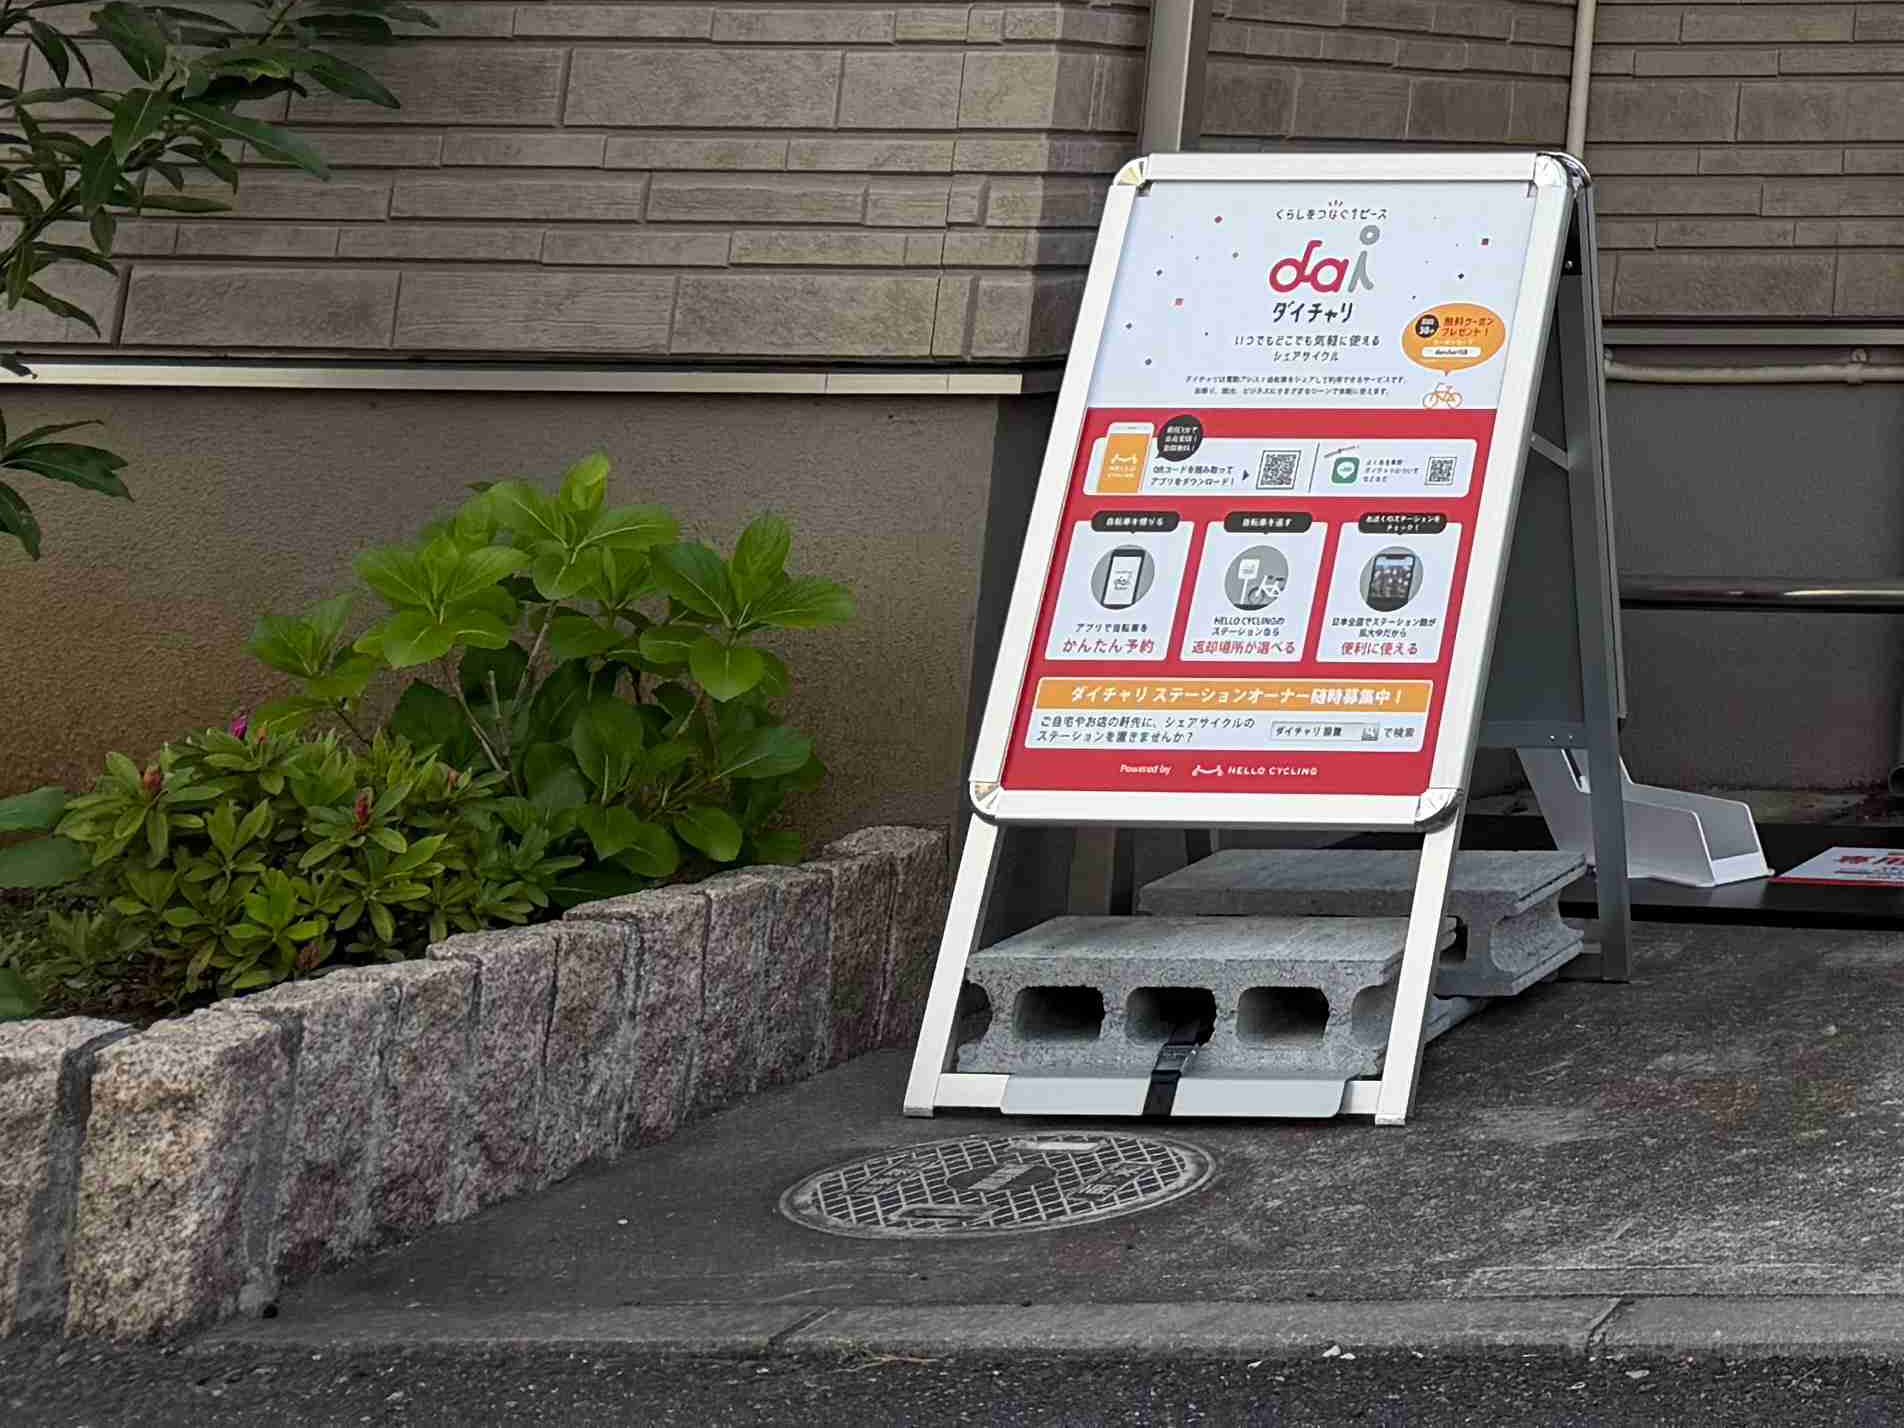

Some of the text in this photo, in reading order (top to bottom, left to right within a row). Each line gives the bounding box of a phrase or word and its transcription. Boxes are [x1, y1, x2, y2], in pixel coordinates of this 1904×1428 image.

[1269, 224, 1381, 293] dai
[1272, 300, 1354, 324] ダイチャリ
[1234, 334, 1381, 347] いつでもどこでも気軽に使える
[1272, 351, 1340, 362] シェアサイクル
[1074, 623, 1149, 633] アプリで自転車を
[1062, 638, 1155, 655] かんたん予約
[1191, 640, 1296, 656] 返却場所が選べる
[1341, 641, 1419, 656] 便利に使える
[1071, 685, 1150, 704] ダイチャリ
[1275, 726, 1321, 738] ダイチャリ
[1158, 764, 1172, 777] by
[1227, 766, 1319, 776] HELLO CYCLING
